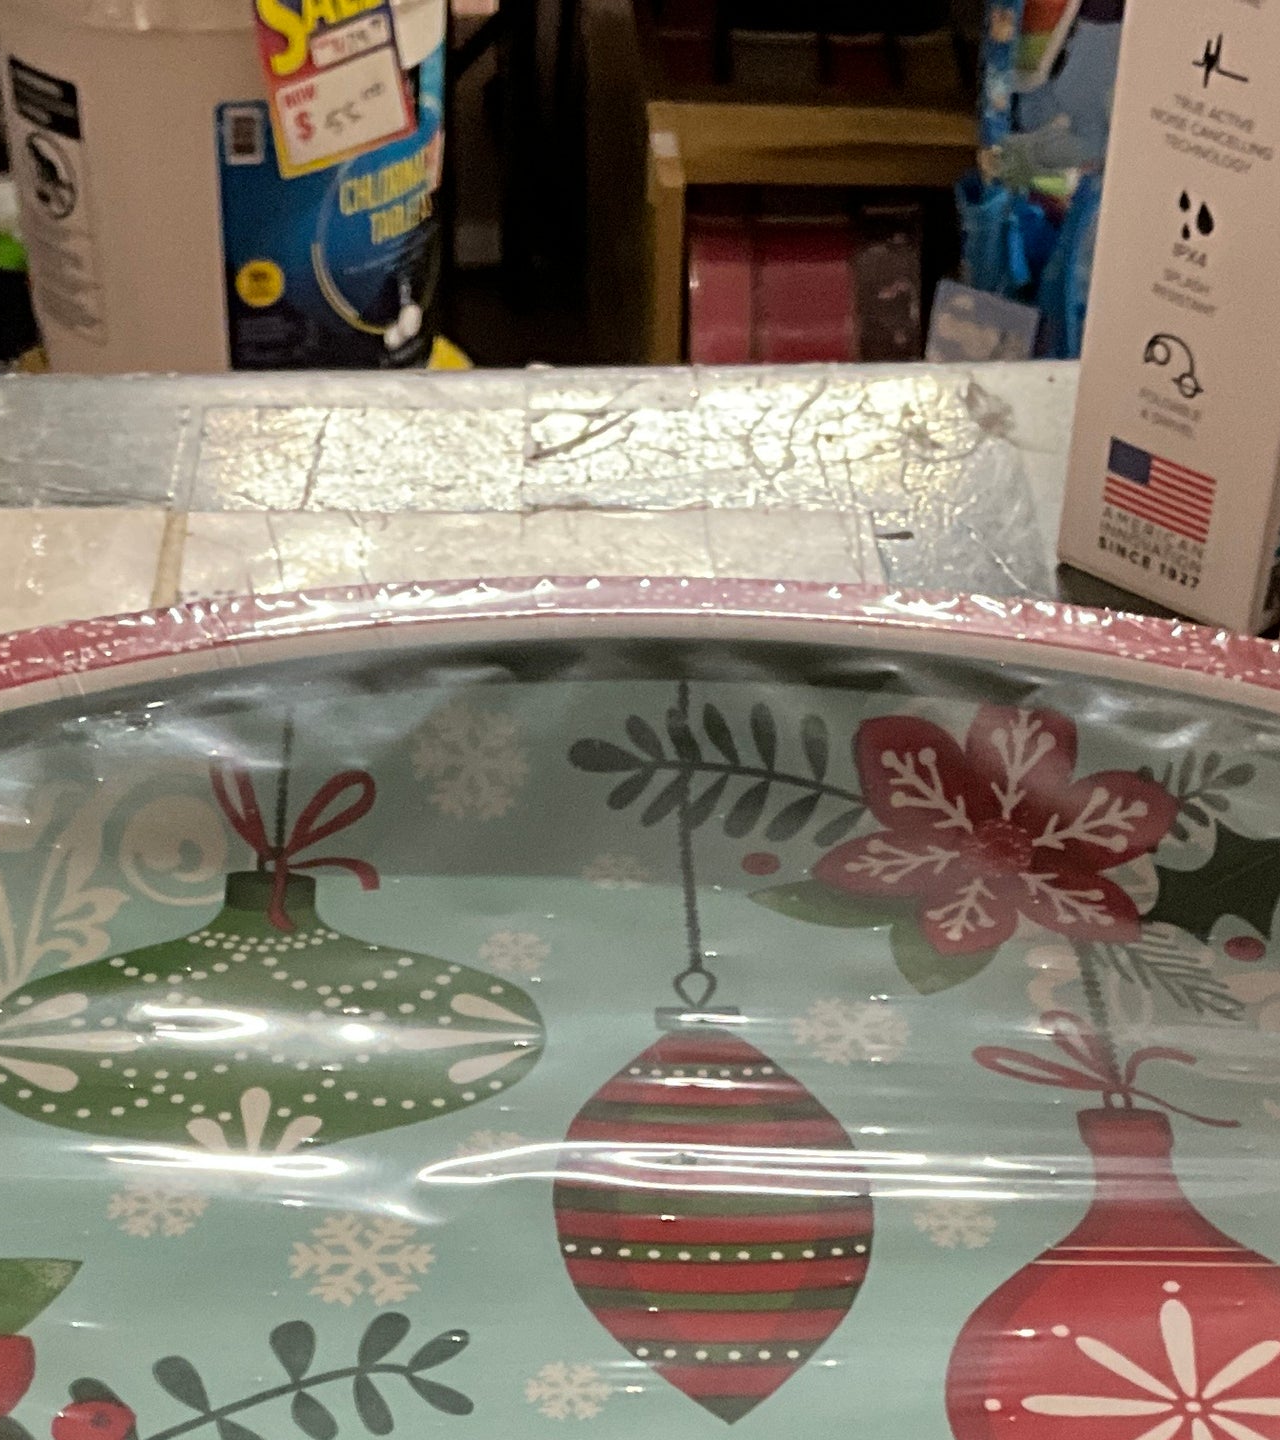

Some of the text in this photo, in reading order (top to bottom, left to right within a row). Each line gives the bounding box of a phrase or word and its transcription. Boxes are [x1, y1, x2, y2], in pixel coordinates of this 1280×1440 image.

[1103, 506, 1205, 560] AMERICAN
[1097, 535, 1200, 589] SINCE 1927
